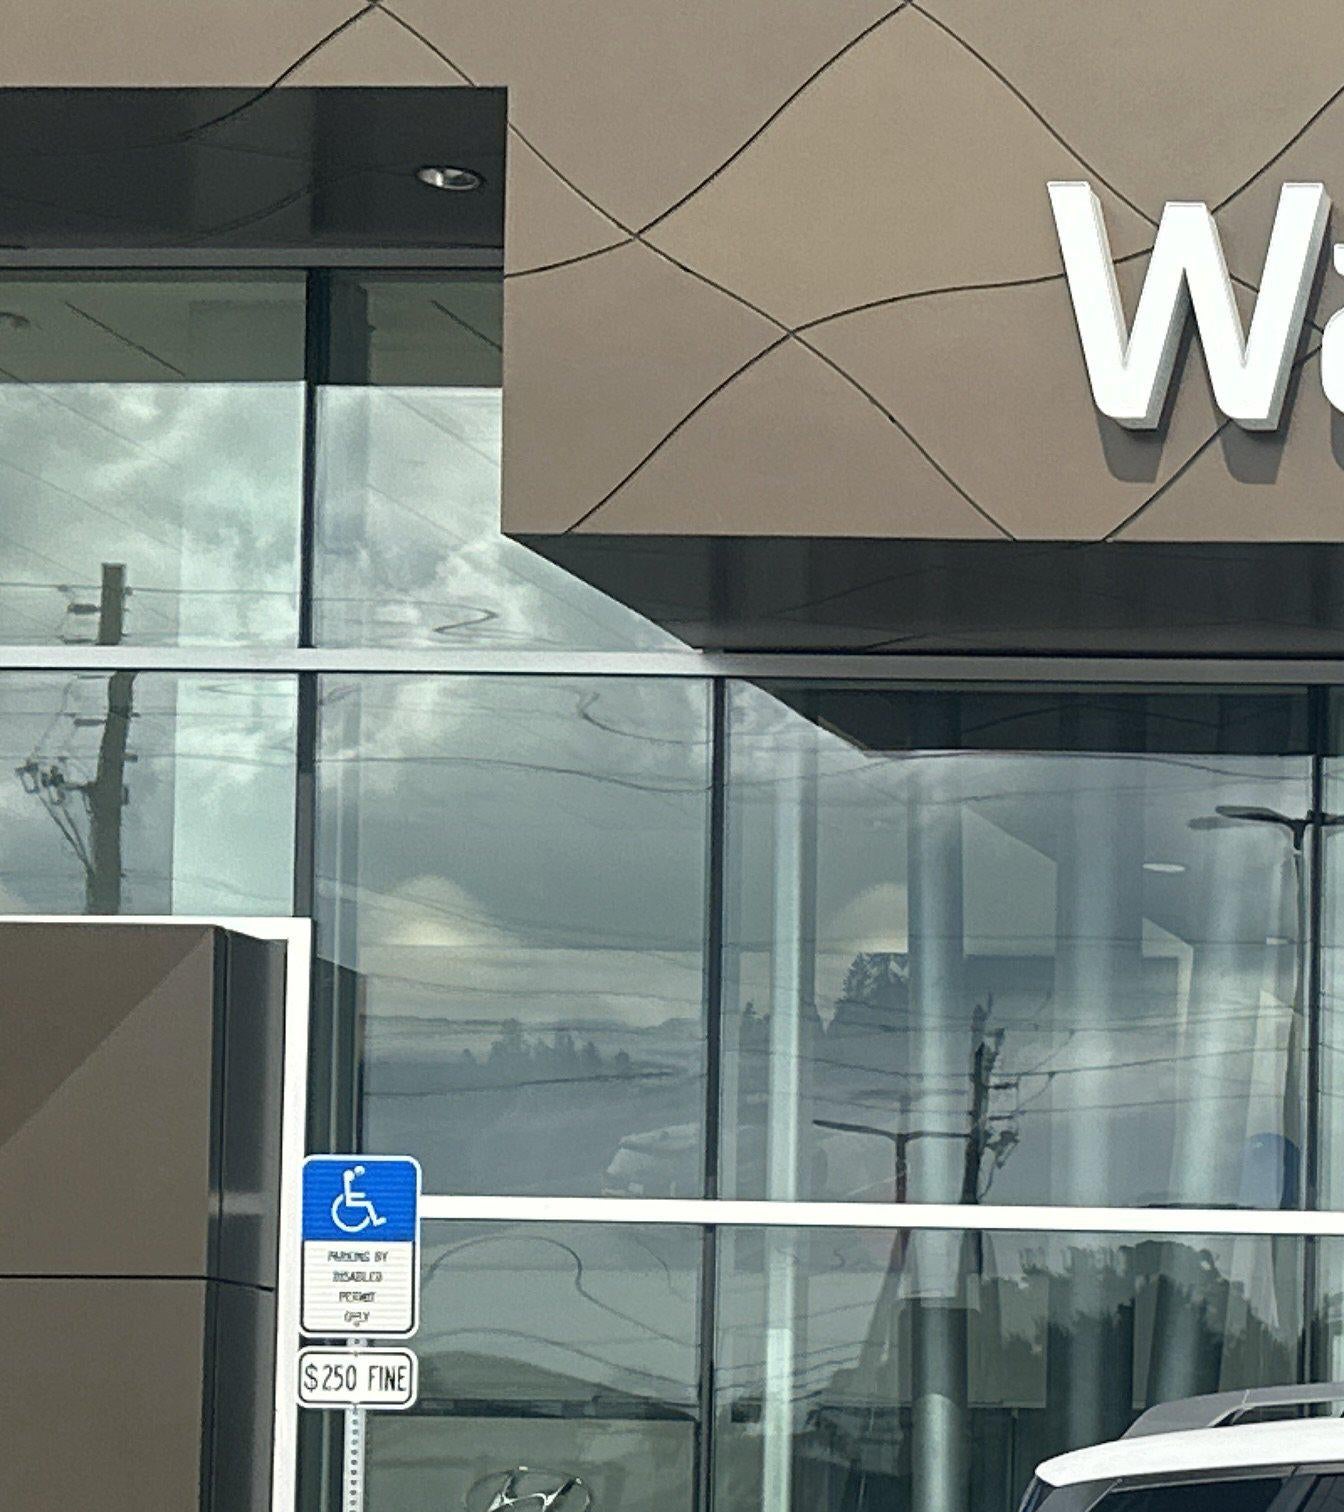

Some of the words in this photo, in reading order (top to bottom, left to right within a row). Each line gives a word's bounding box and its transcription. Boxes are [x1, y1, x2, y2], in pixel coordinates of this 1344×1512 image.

[375, 1251, 389, 1262] BY
[303, 1363, 357, 1393] $250
[368, 1365, 407, 1391] FINE
